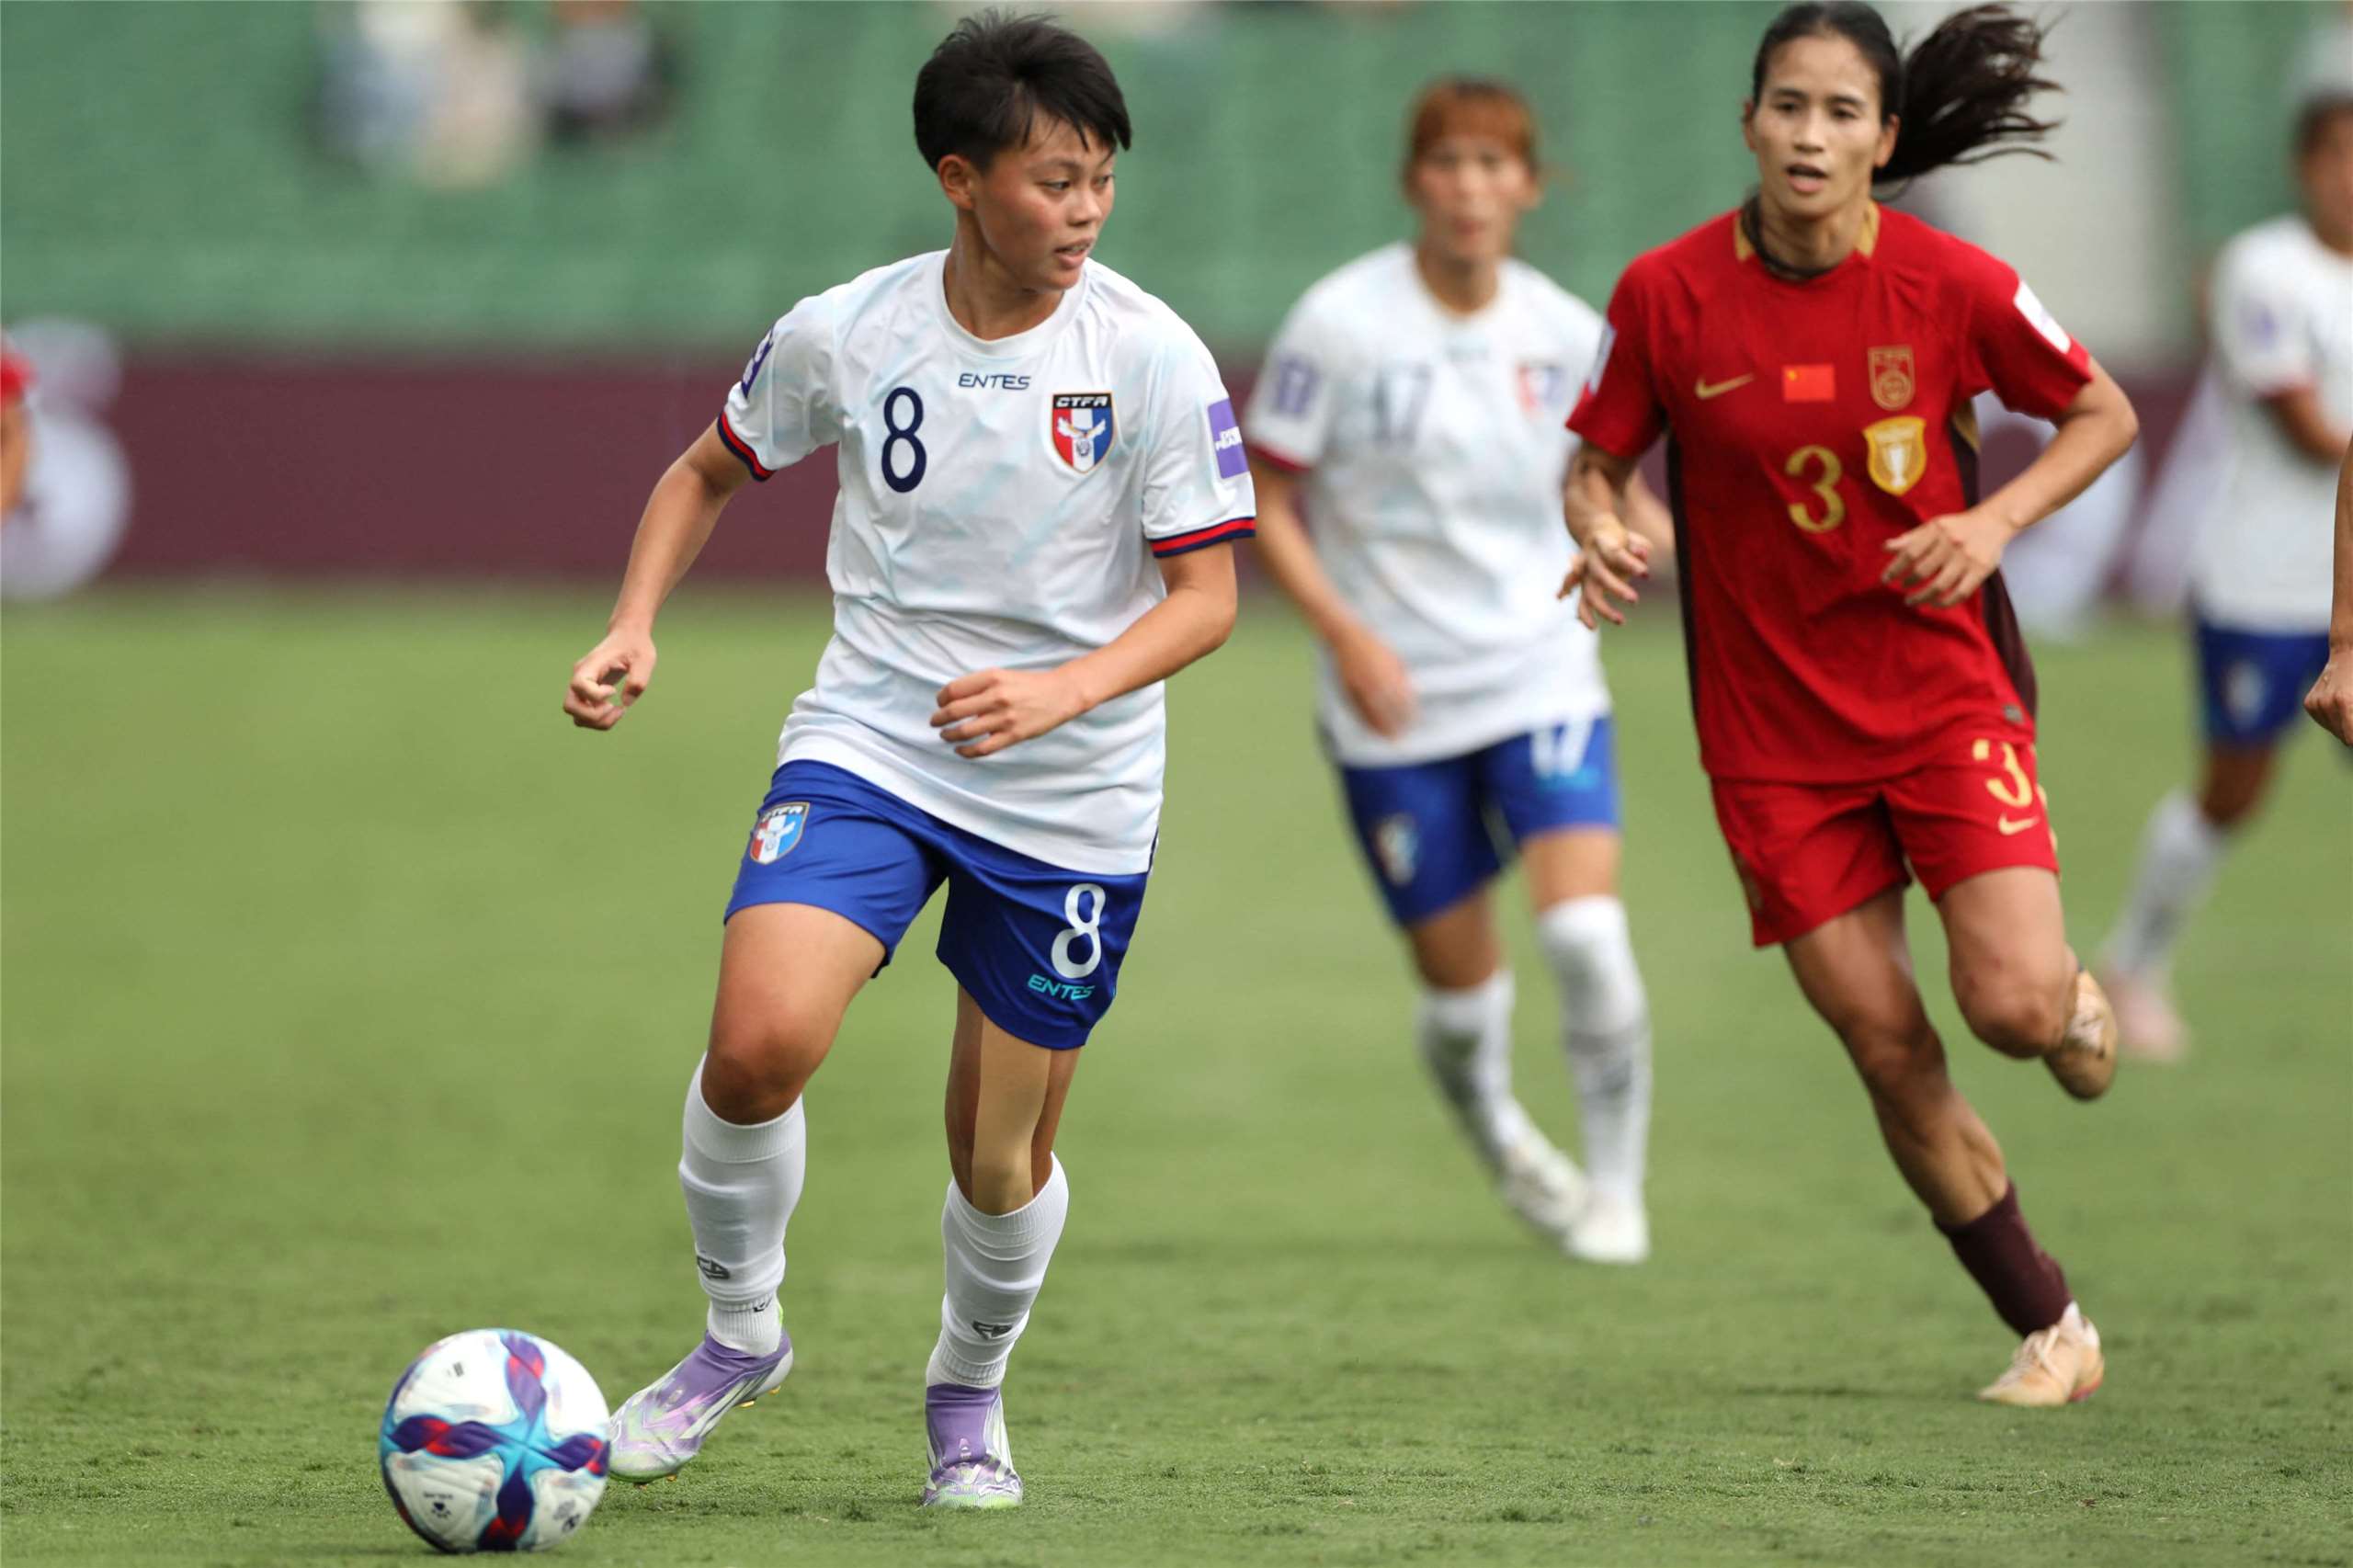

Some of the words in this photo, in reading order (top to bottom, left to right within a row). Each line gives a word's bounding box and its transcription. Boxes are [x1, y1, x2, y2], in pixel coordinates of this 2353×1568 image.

[959, 373, 1030, 390] ENTES
[1056, 396, 1108, 407] CTFA
[881, 387, 926, 493] 8
[1785, 445, 1845, 533] 3
[1972, 739, 2033, 808] 3
[1051, 883, 1107, 979] 8
[1028, 974, 1096, 1000] ENTES
